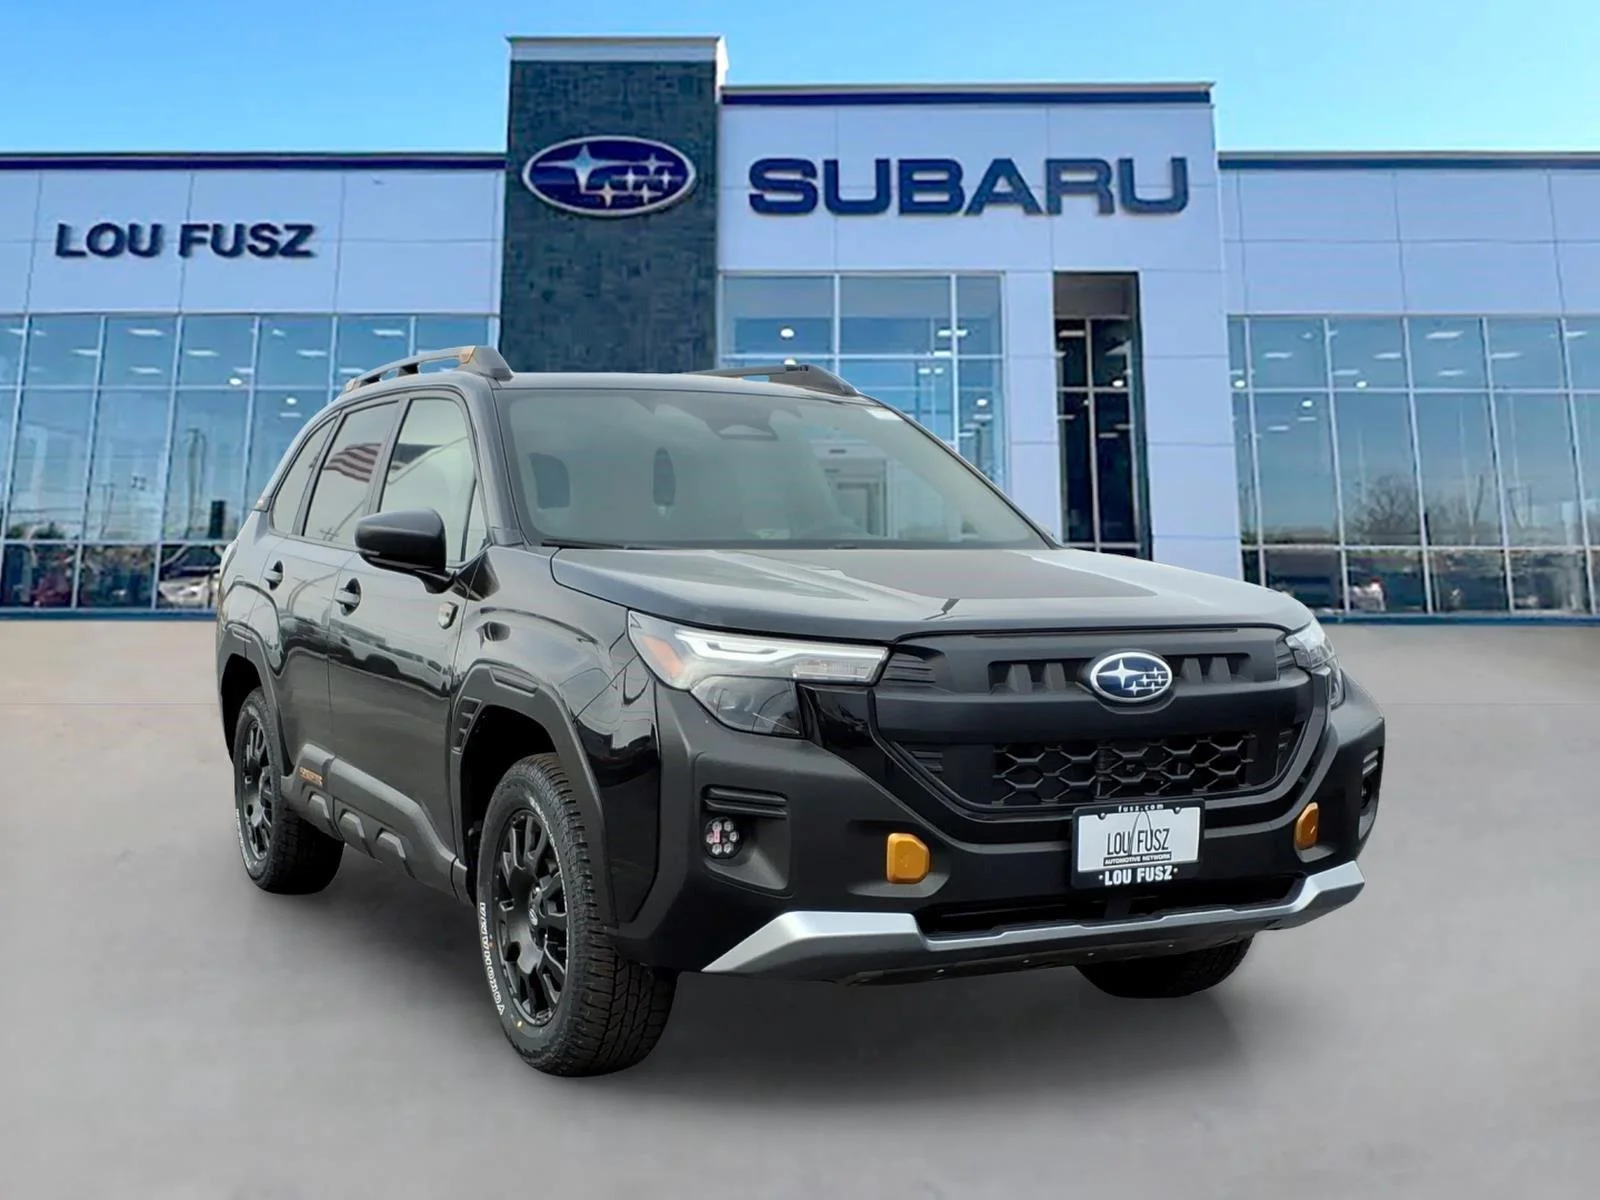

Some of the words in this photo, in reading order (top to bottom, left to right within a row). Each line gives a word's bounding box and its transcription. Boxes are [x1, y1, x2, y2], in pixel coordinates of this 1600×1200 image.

[748, 157, 1188, 215] SUBARU
[55, 222, 164, 258] LOU
[177, 222, 316, 258] FUSZ
[1118, 803, 1164, 813] fusz.com
[1107, 831, 1131, 855] LOU
[1137, 828, 1170, 853] FUSZ
[1104, 855, 1141, 865] AUTOMOTIVE
[1142, 853, 1171, 862] NETWORK
[1104, 868, 1132, 886] LOU
[1137, 865, 1173, 883] FUSZ
